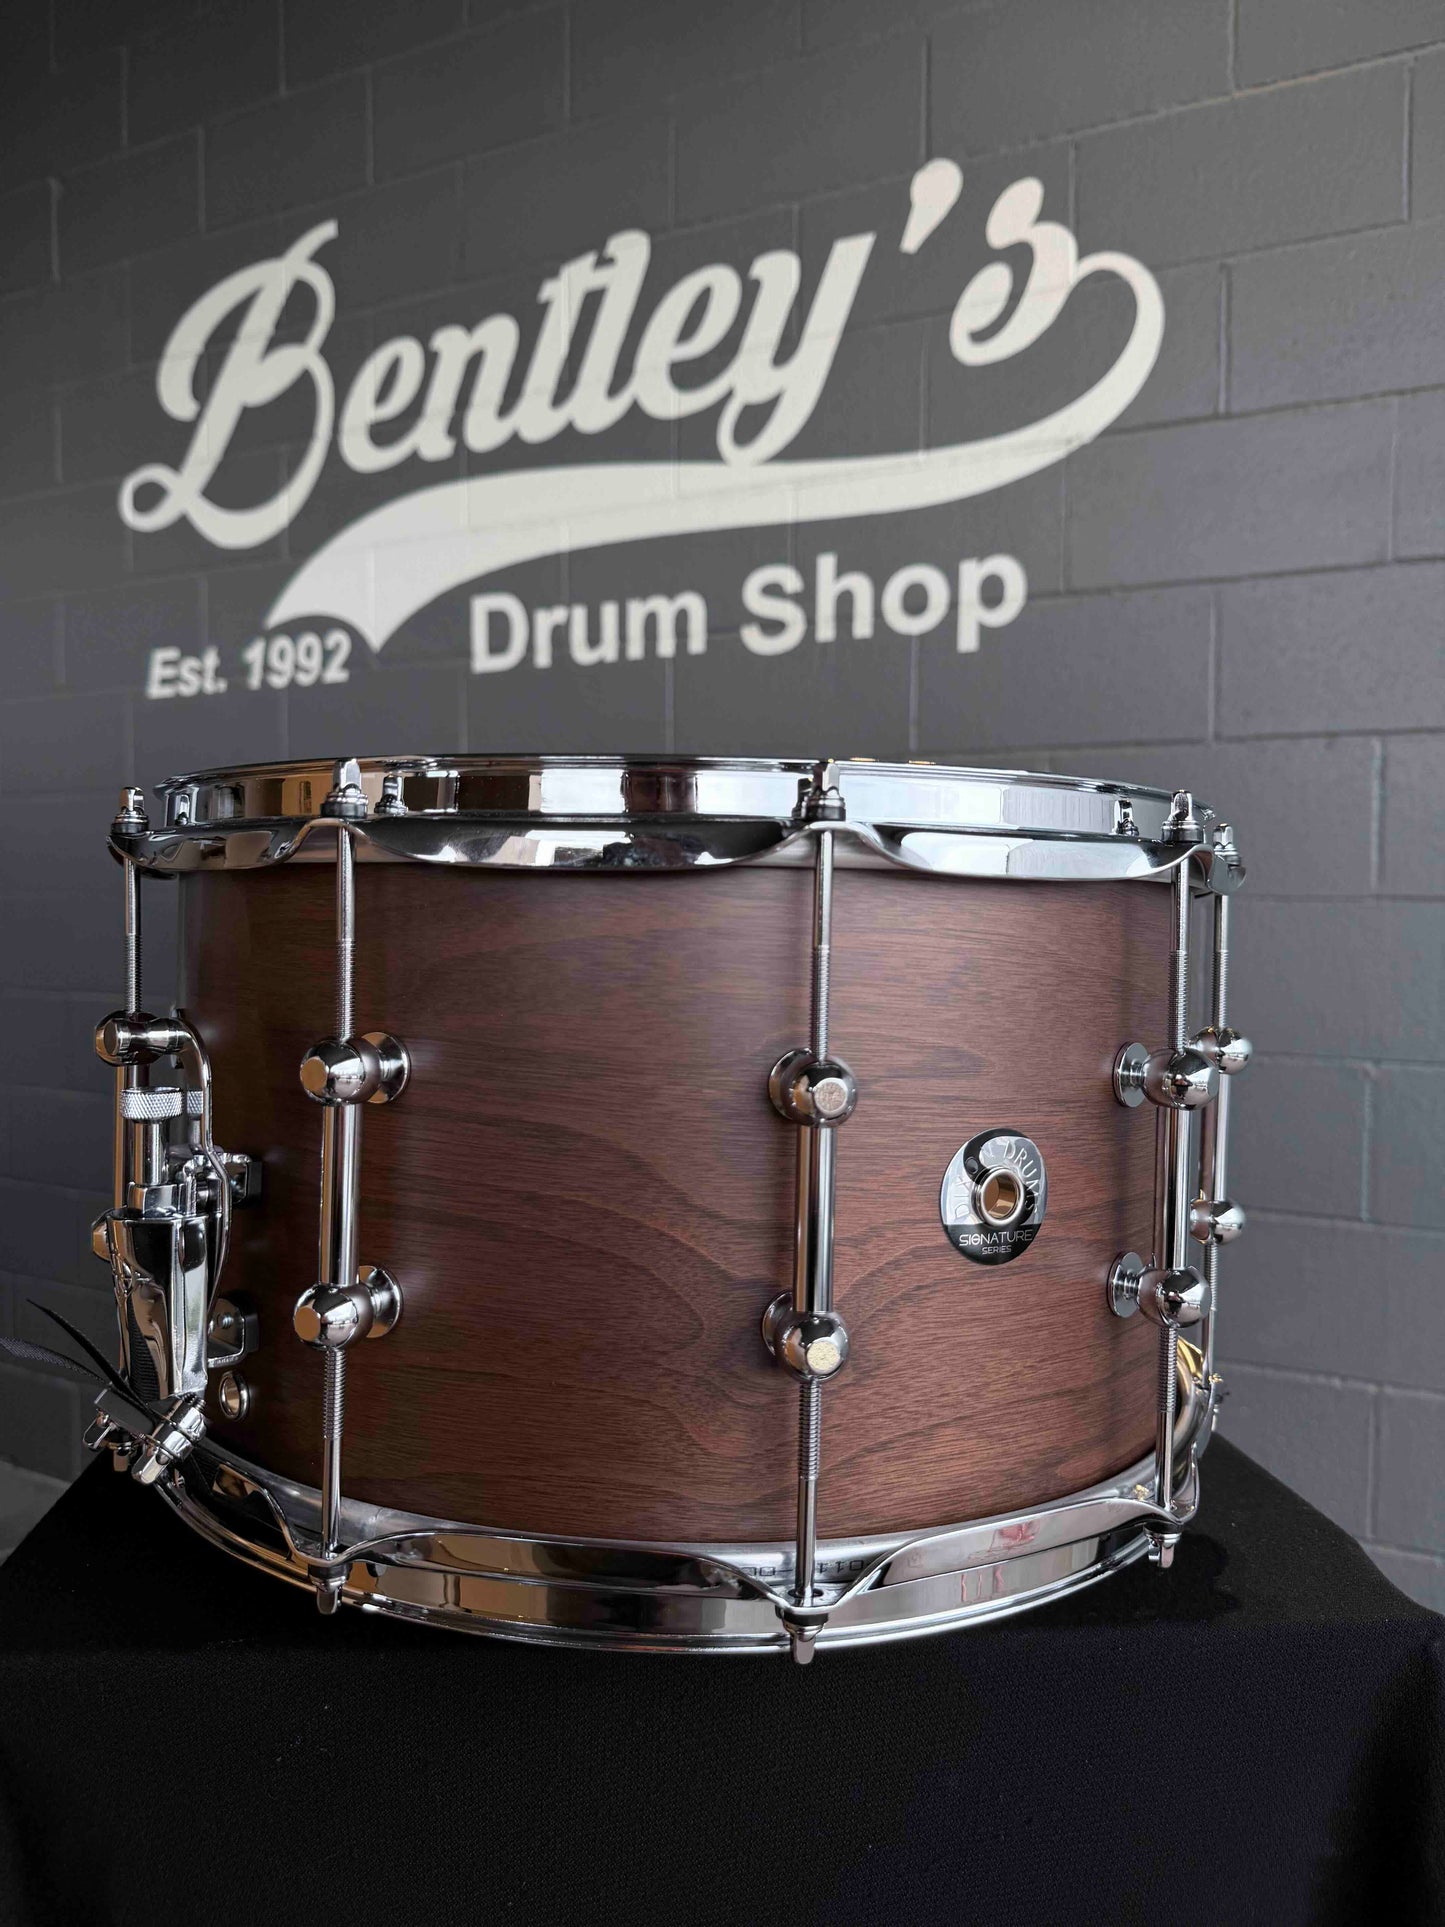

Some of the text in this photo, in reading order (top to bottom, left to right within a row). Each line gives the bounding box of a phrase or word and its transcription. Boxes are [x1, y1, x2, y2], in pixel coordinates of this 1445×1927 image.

[119, 157, 1165, 549] Bentley's
[469, 551, 1028, 675] Drum Shop
[146, 628, 352, 700] Est. 1992
[958, 1229, 1034, 1247] SIGNATURE
[981, 1244, 1013, 1255] SERIES
